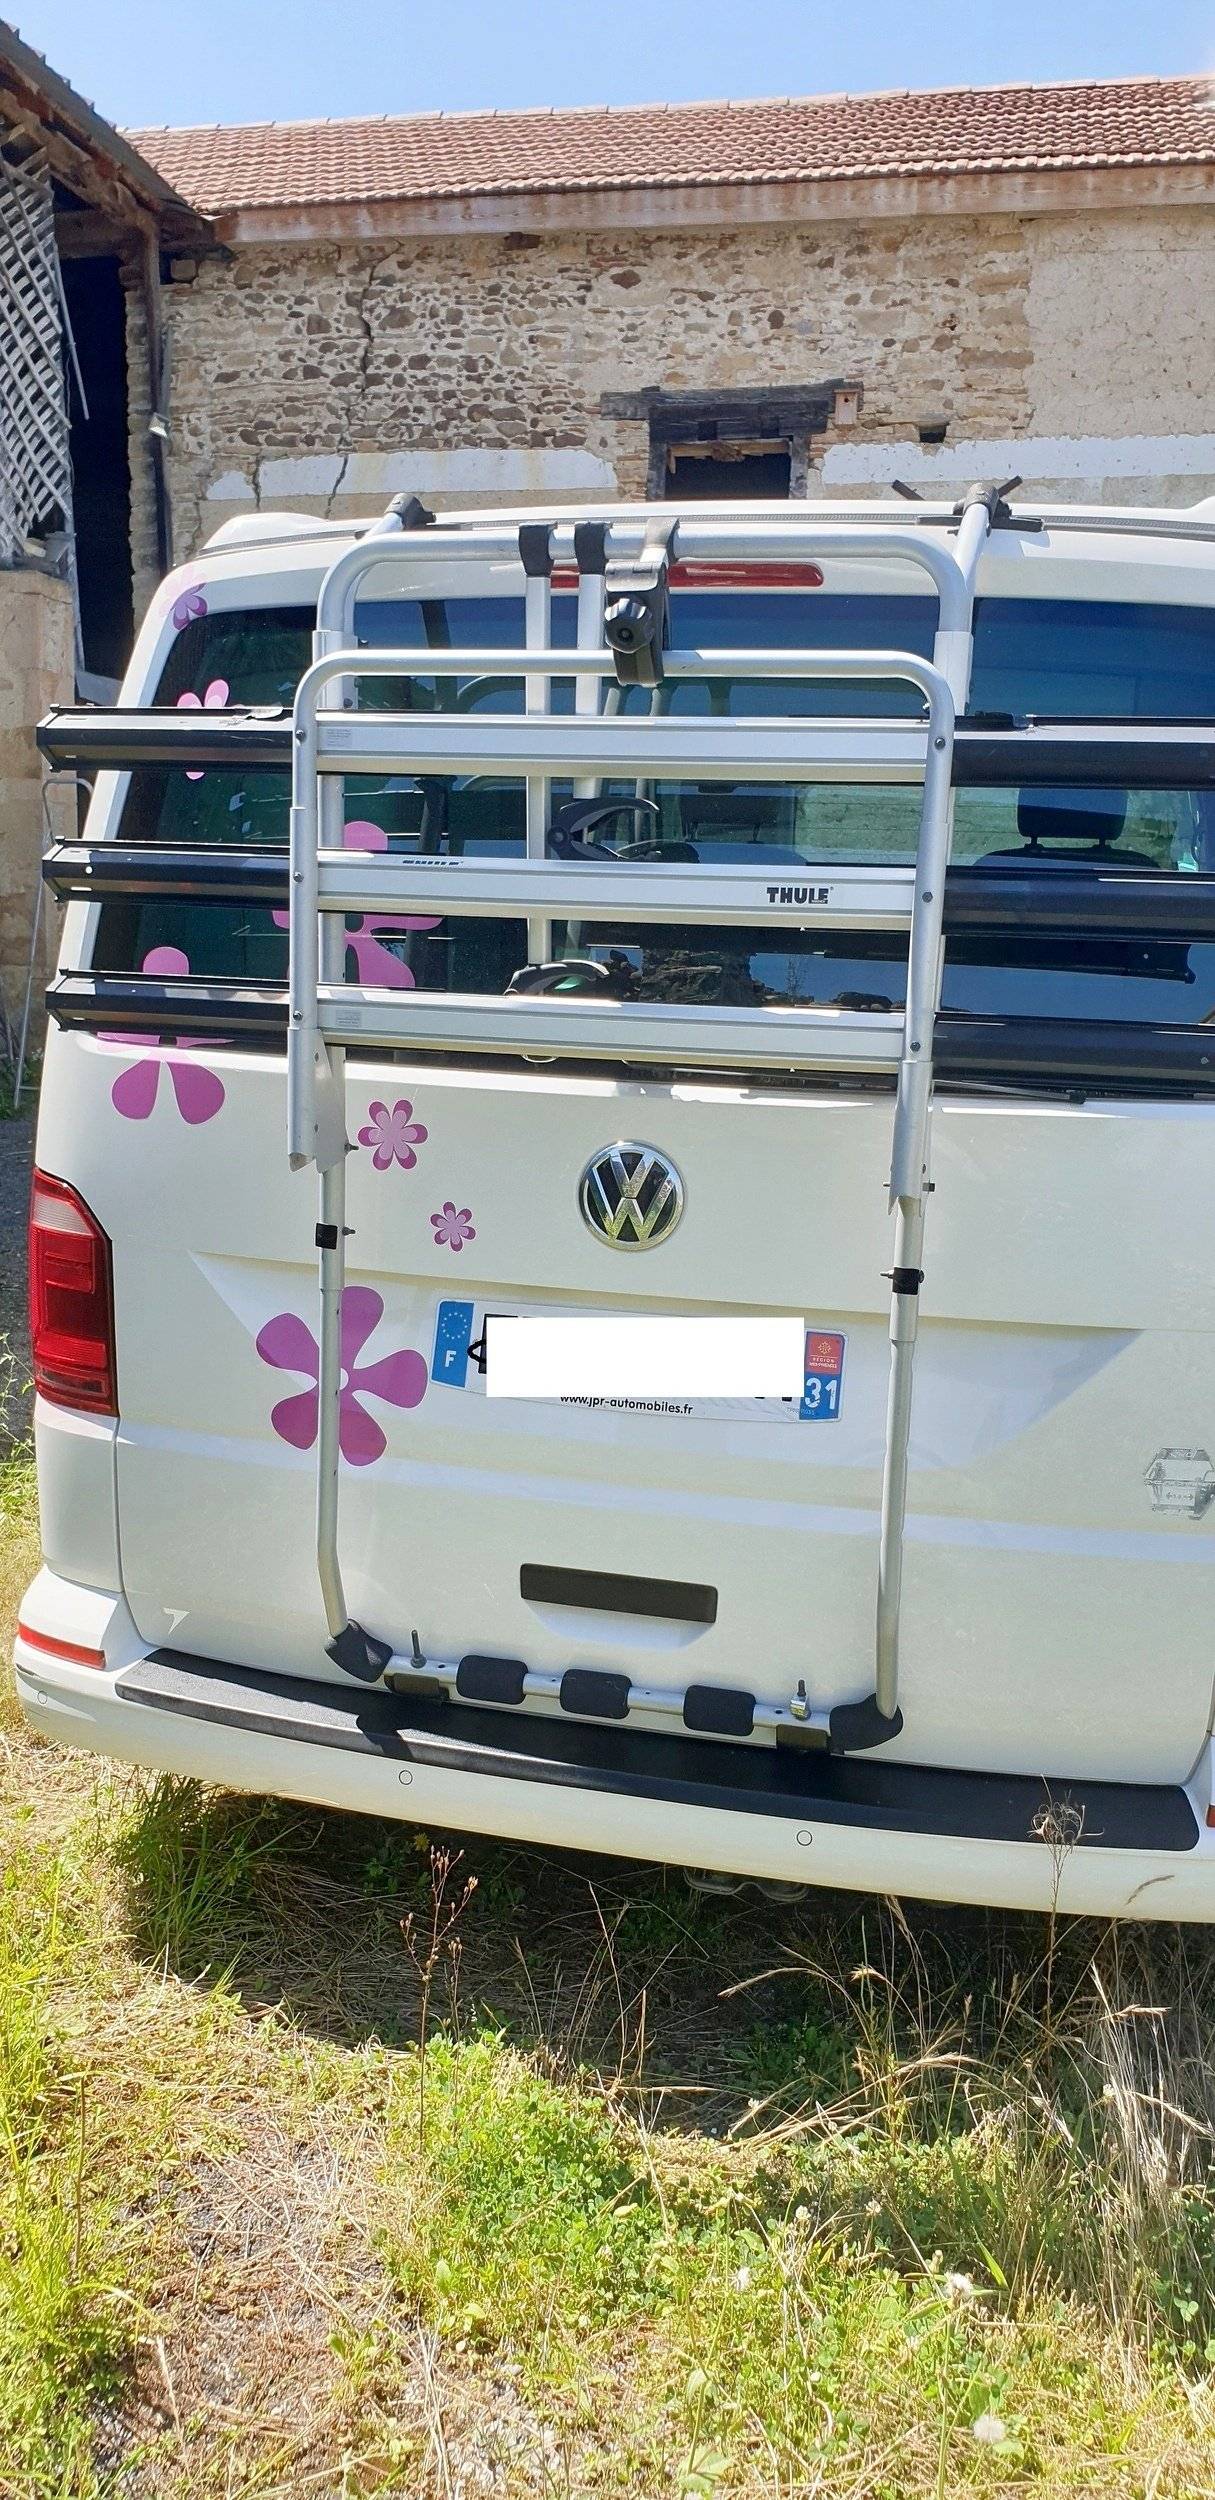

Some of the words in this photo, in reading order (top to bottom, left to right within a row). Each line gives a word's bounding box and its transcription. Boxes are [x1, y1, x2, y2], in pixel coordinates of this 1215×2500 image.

[766, 886, 830, 905] THULE
[582, 1142, 683, 1249] VW
[444, 1350, 457, 1368] F
[804, 1377, 838, 1410] 31
[560, 1396, 694, 1415] www.jpr-automobiles.fr
